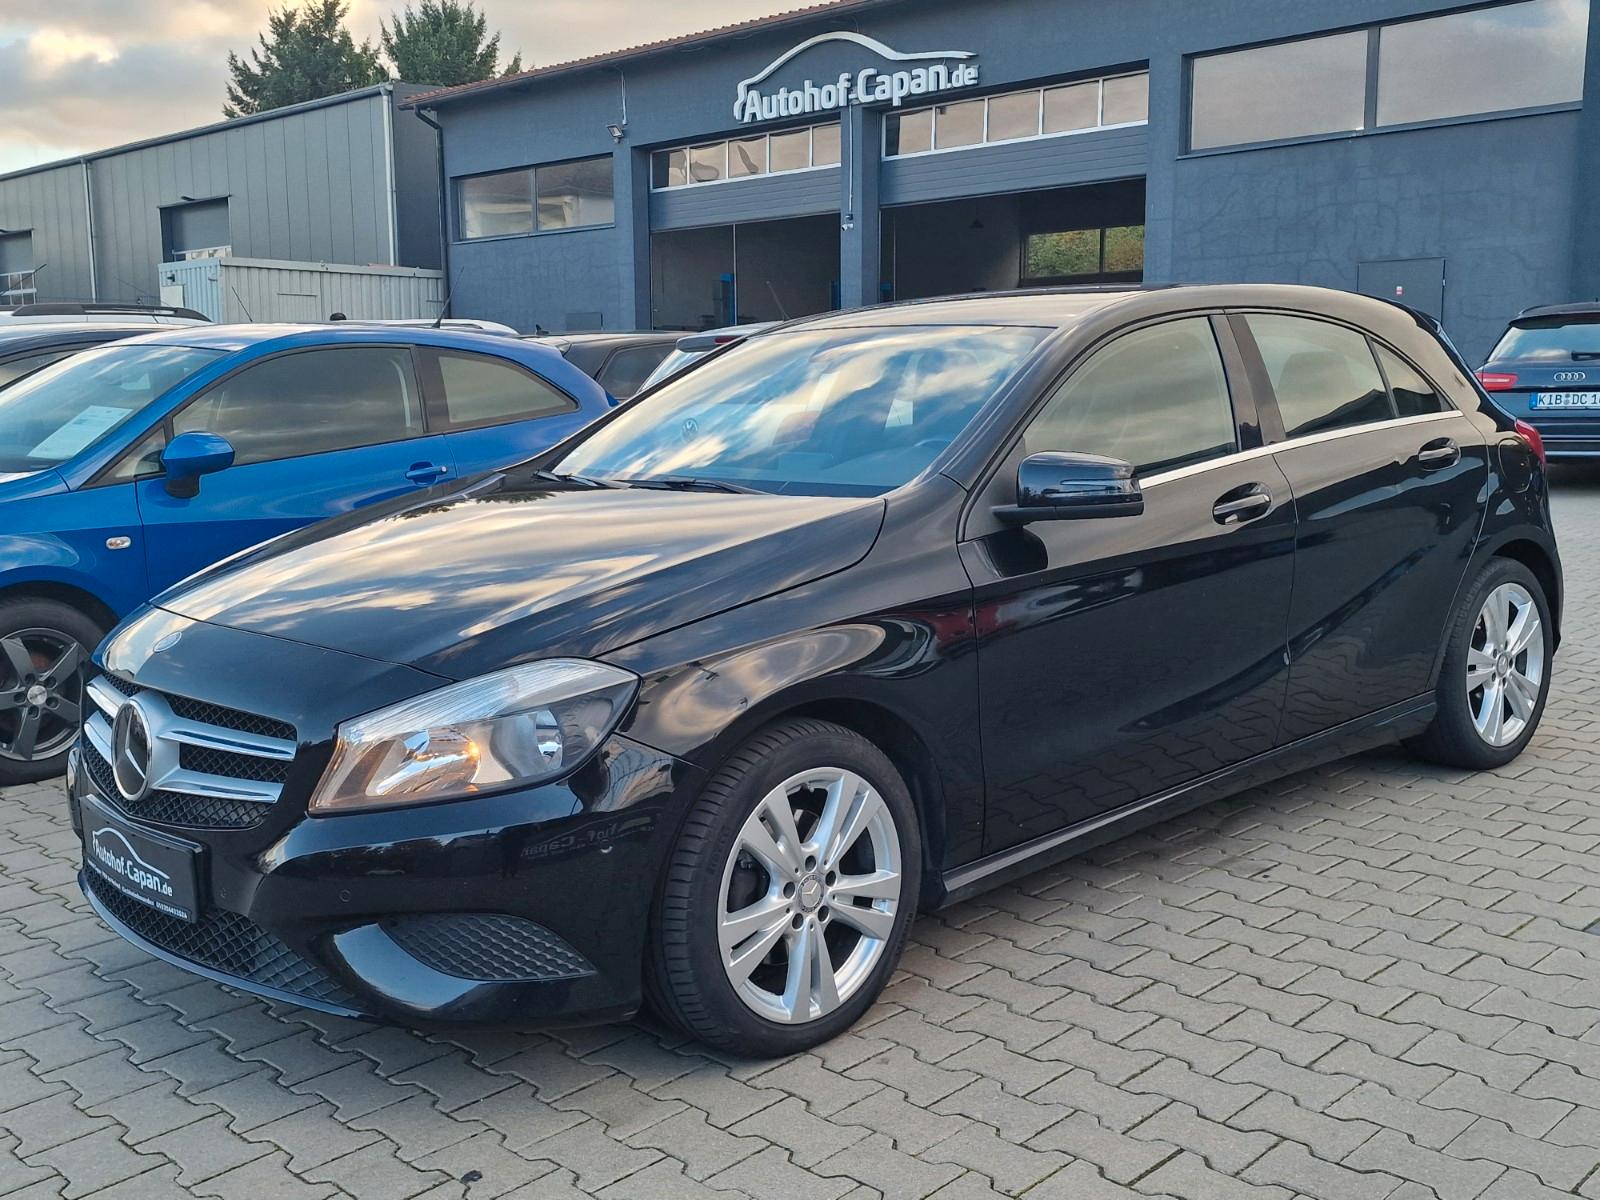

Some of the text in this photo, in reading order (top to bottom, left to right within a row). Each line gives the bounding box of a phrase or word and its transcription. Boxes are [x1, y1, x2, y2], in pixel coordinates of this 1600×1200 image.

[1538, 394, 1600, 406] KIB DC 1
